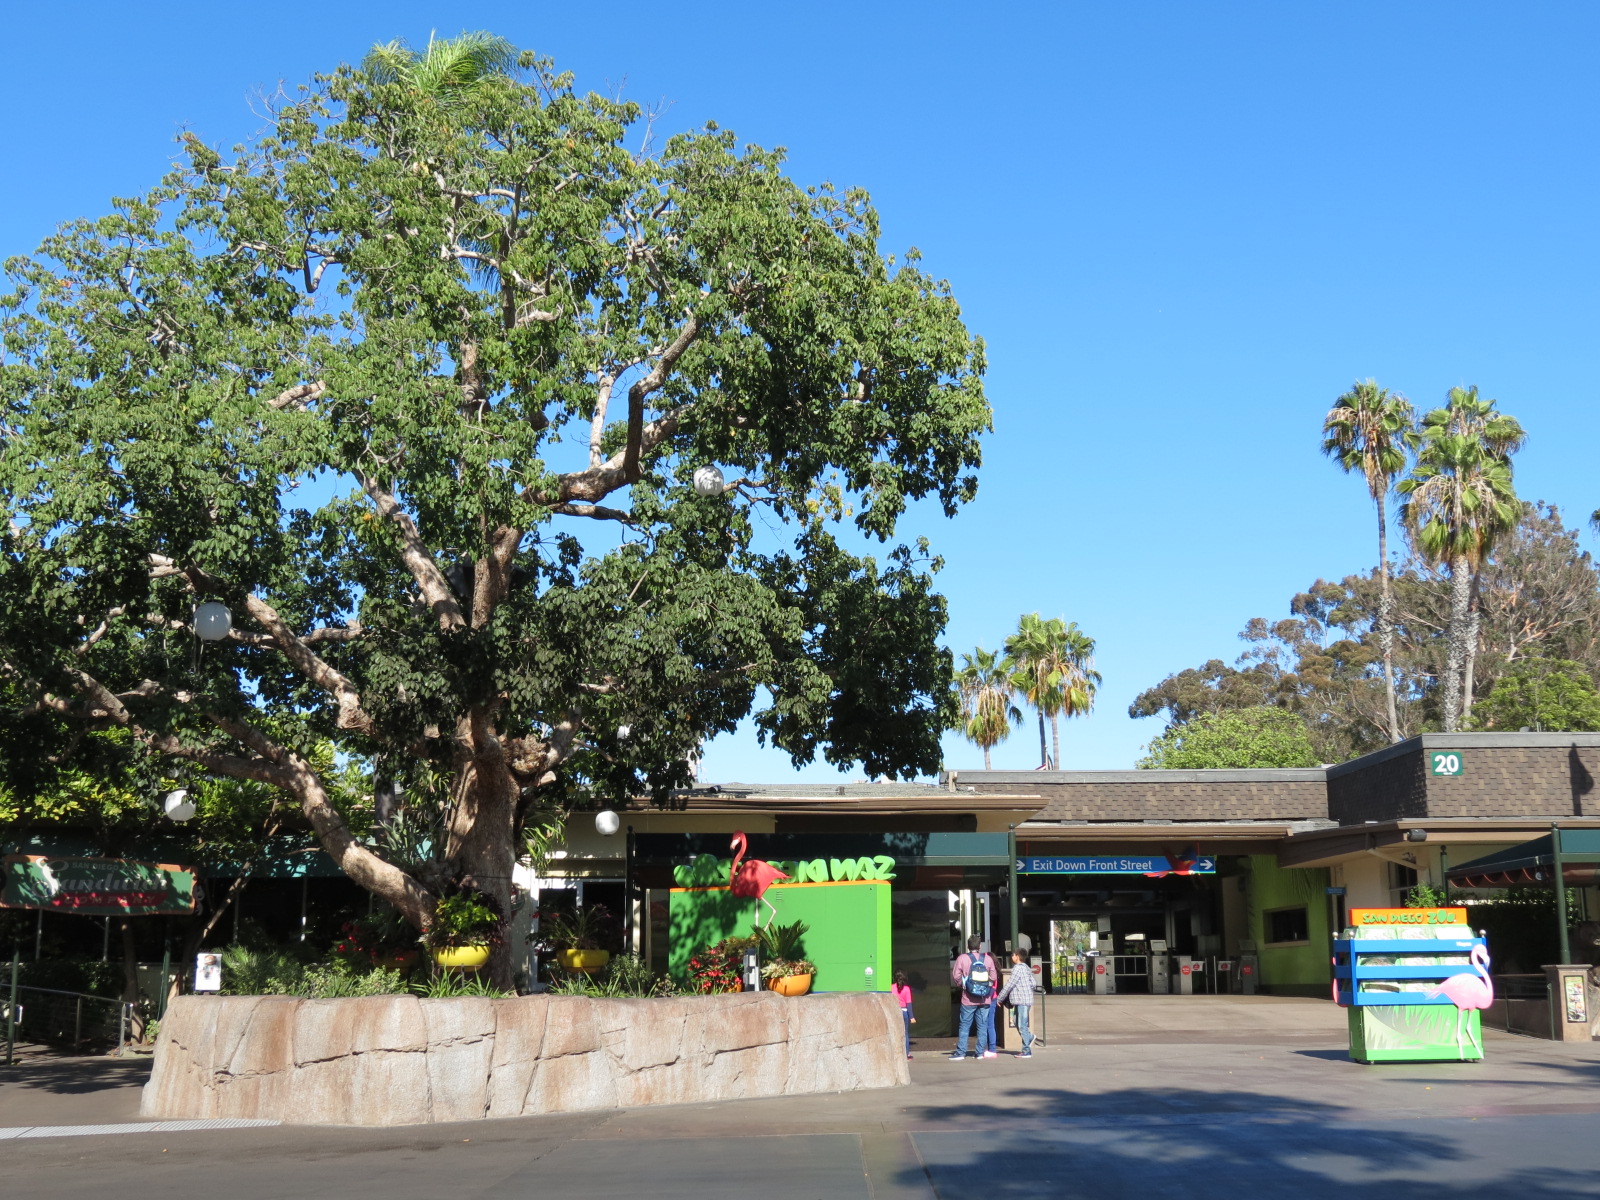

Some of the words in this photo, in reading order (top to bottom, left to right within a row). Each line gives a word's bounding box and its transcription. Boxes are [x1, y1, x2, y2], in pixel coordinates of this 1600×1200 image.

[1434, 754, 1459, 773] 20
[92, 863, 119, 871] DIEGO
[1033, 859, 1053, 870] Exit
[1056, 859, 1086, 870] Down
[1089, 859, 1117, 870] Front
[1120, 859, 1152, 870] Street
[1362, 913, 1388, 924] SAN
[1390, 913, 1423, 924] DIEGO
